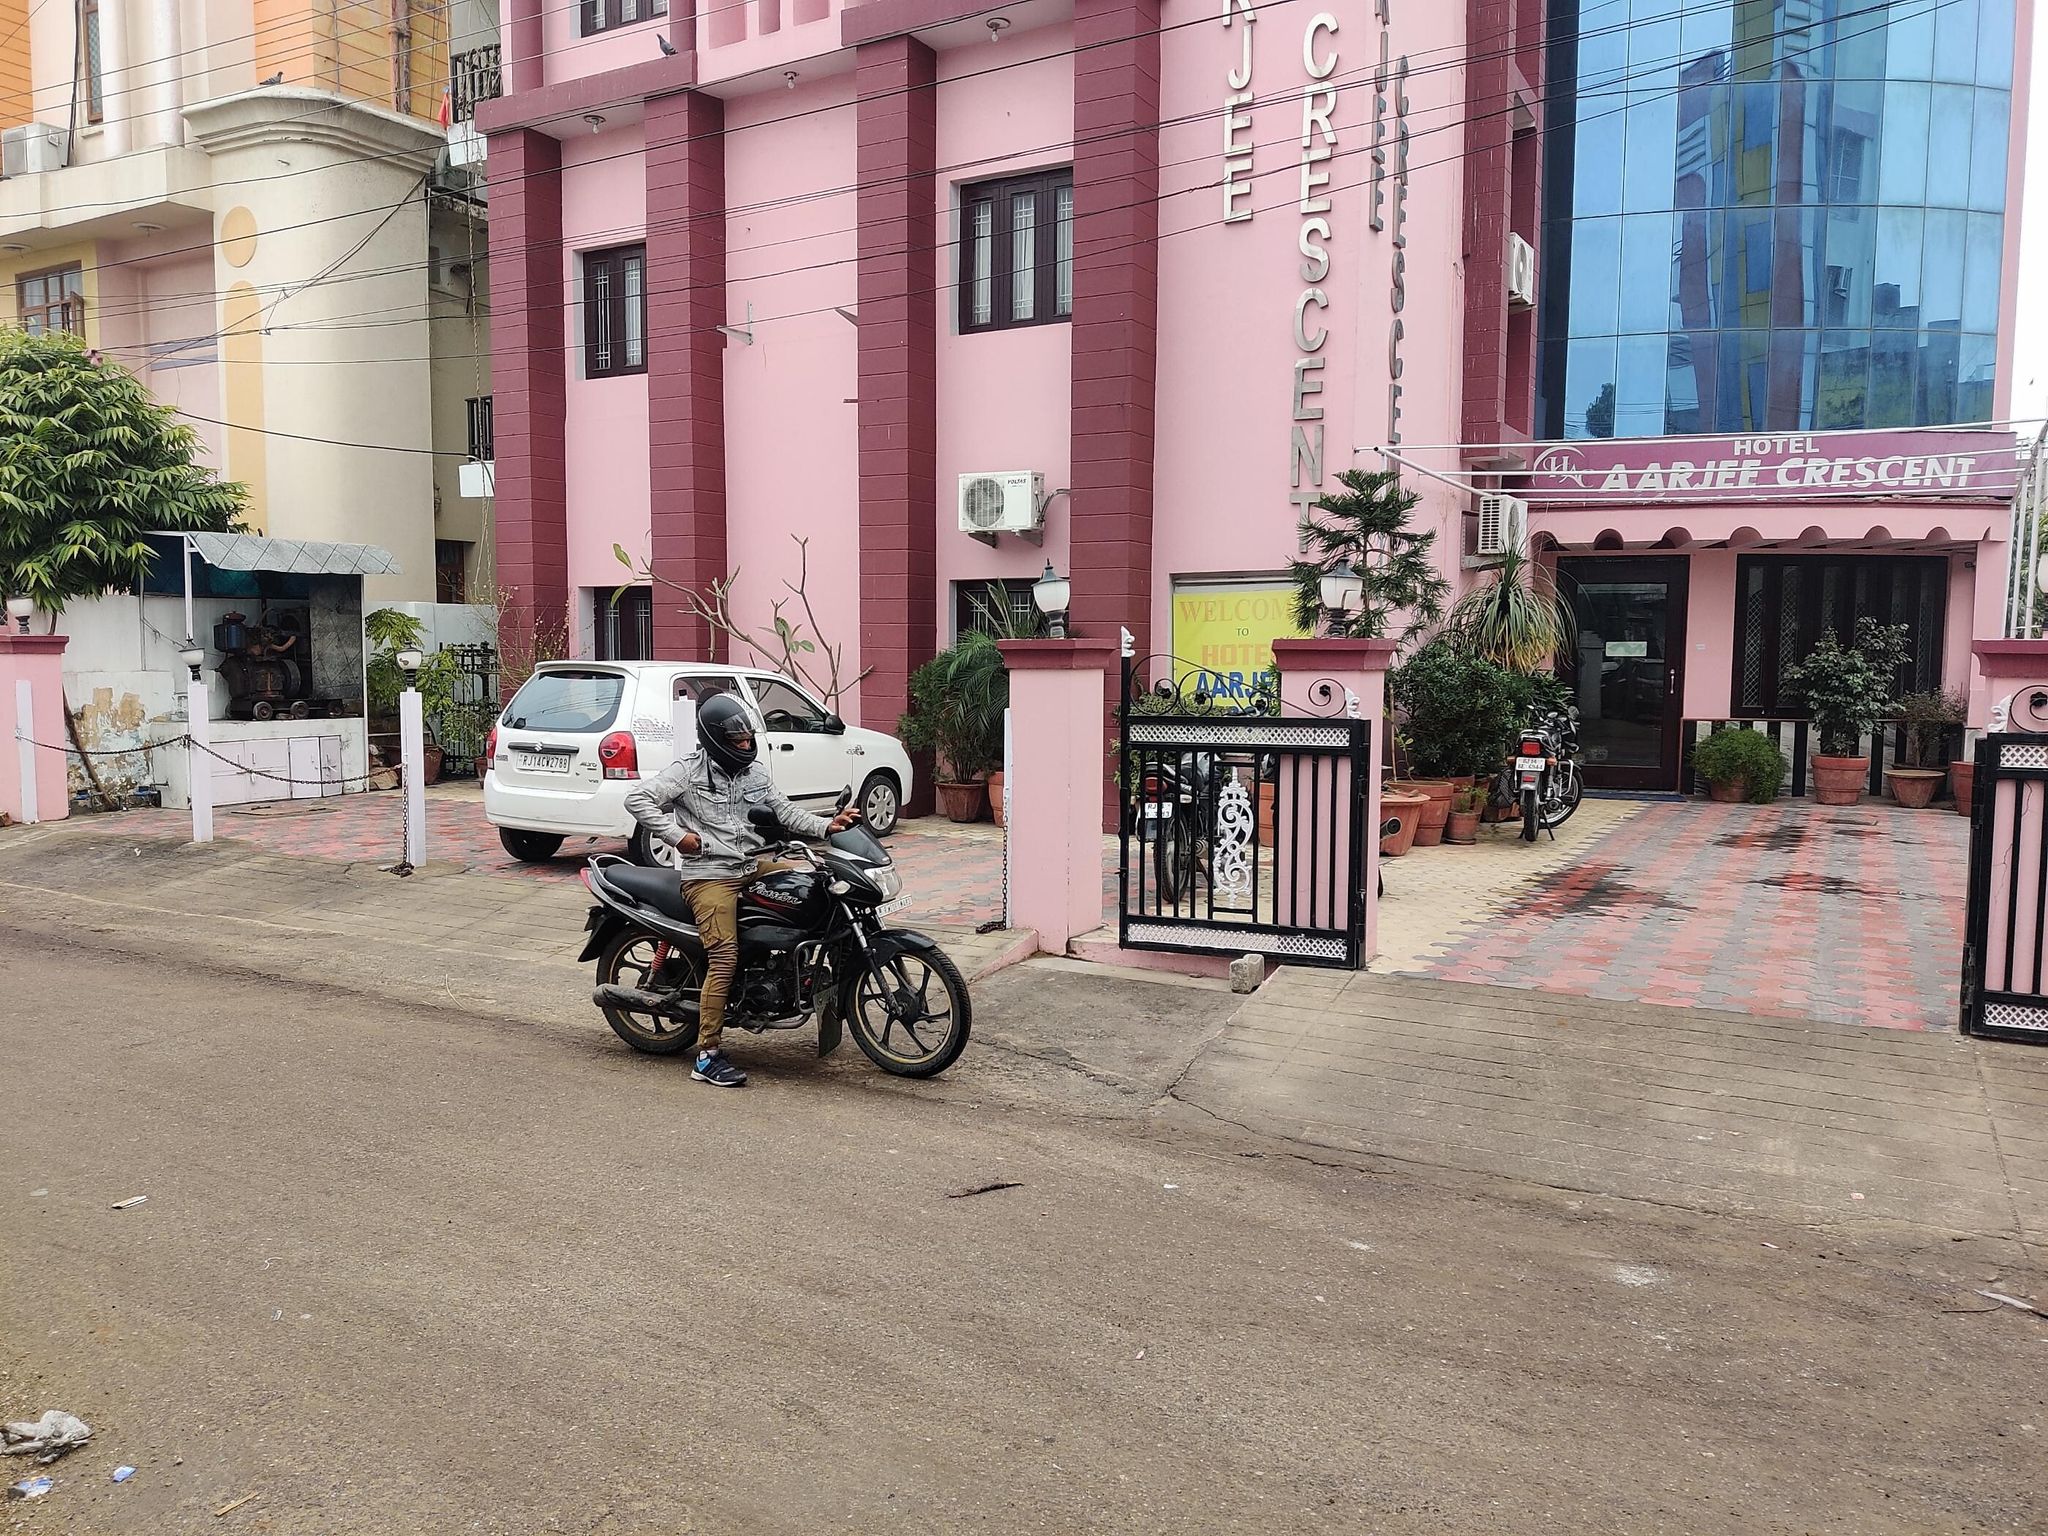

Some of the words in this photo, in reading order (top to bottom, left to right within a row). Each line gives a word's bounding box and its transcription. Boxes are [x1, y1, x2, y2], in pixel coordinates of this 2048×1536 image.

[1289, 12, 1340, 553] CRESCENT
[1733, 437, 1820, 456] HOTEL
[1598, 459, 1762, 492] AARJEE
[1776, 455, 1977, 488] CRESCENT
[1179, 598, 1291, 623] WELCOM
[1235, 626, 1250, 637] TO
[1201, 643, 1270, 666] HOTE
[1195, 670, 1275, 699] AARJE
